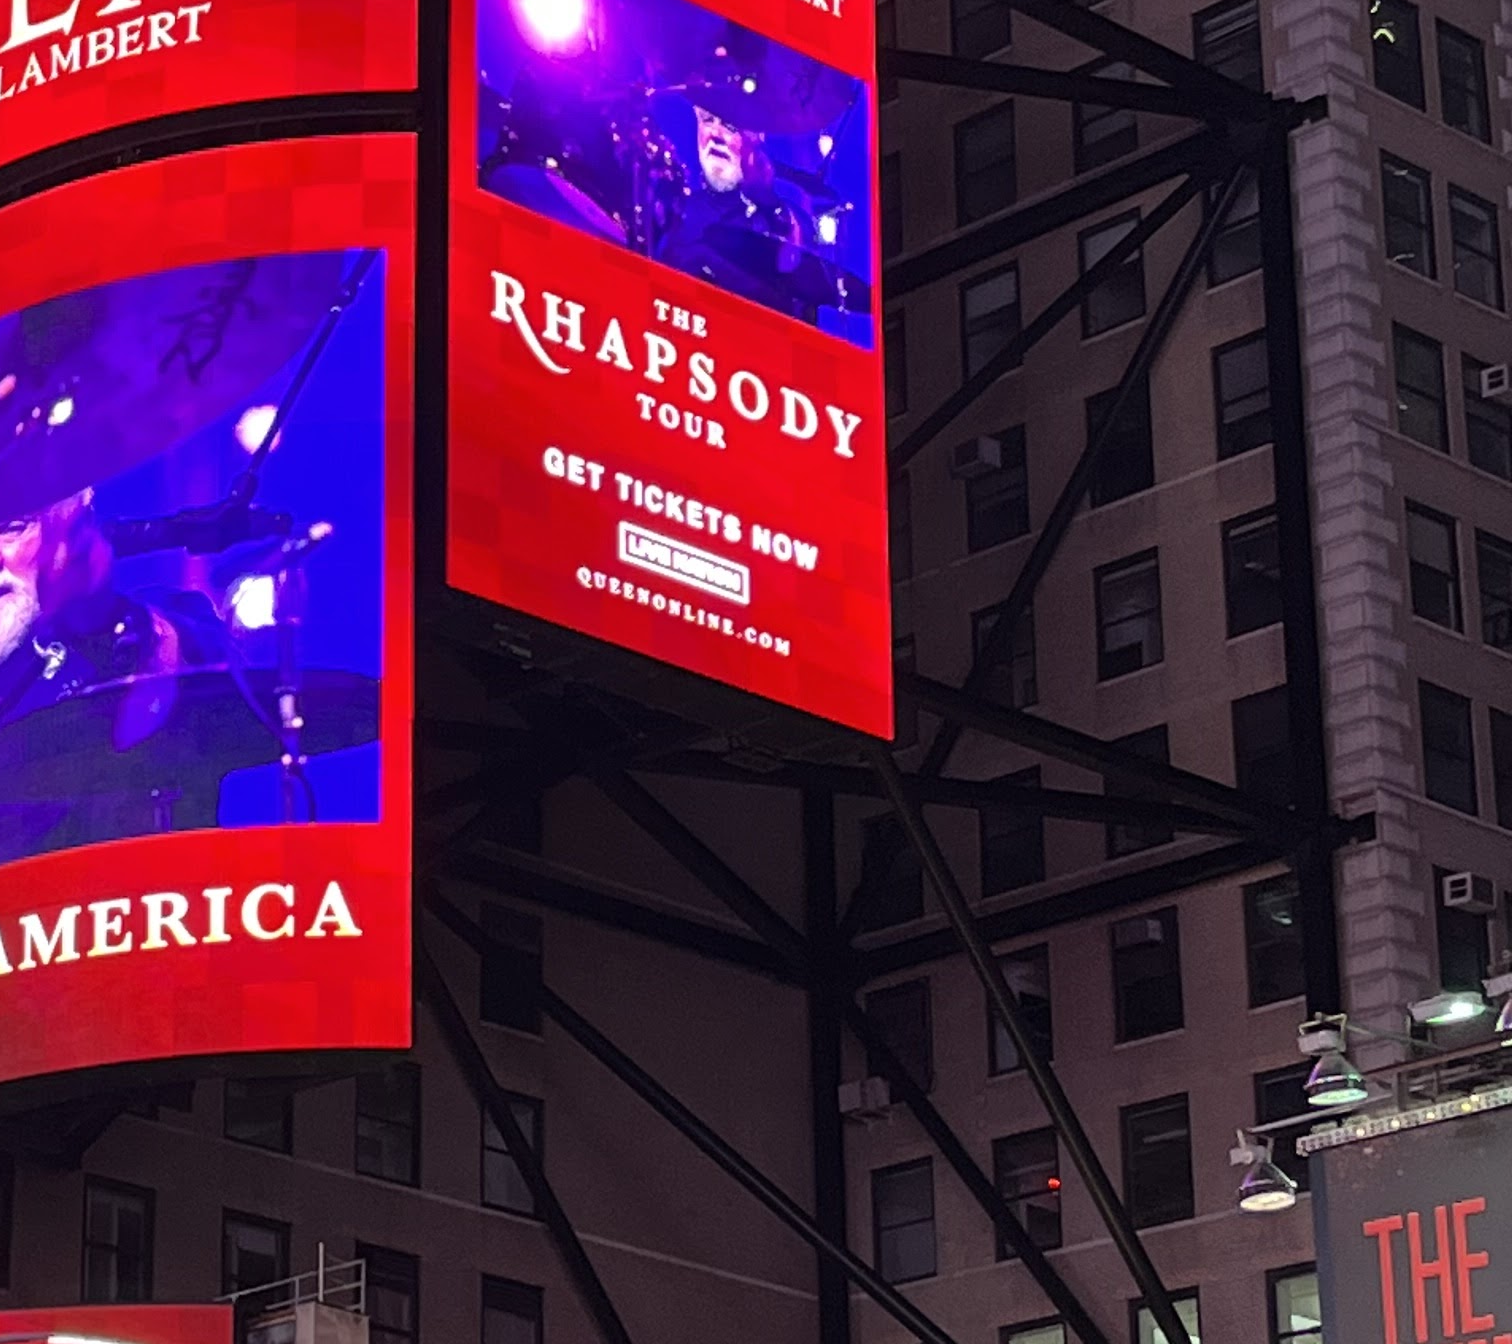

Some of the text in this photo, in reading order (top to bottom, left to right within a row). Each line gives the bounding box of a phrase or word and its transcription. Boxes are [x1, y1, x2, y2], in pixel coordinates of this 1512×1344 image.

[653, 298, 708, 337] THE
[490, 270, 862, 458] RHAPSODY
[635, 393, 727, 449] TOUR
[542, 446, 819, 570] GET TICKETS NOW
[575, 566, 791, 656] QUEENONLINE.COM
